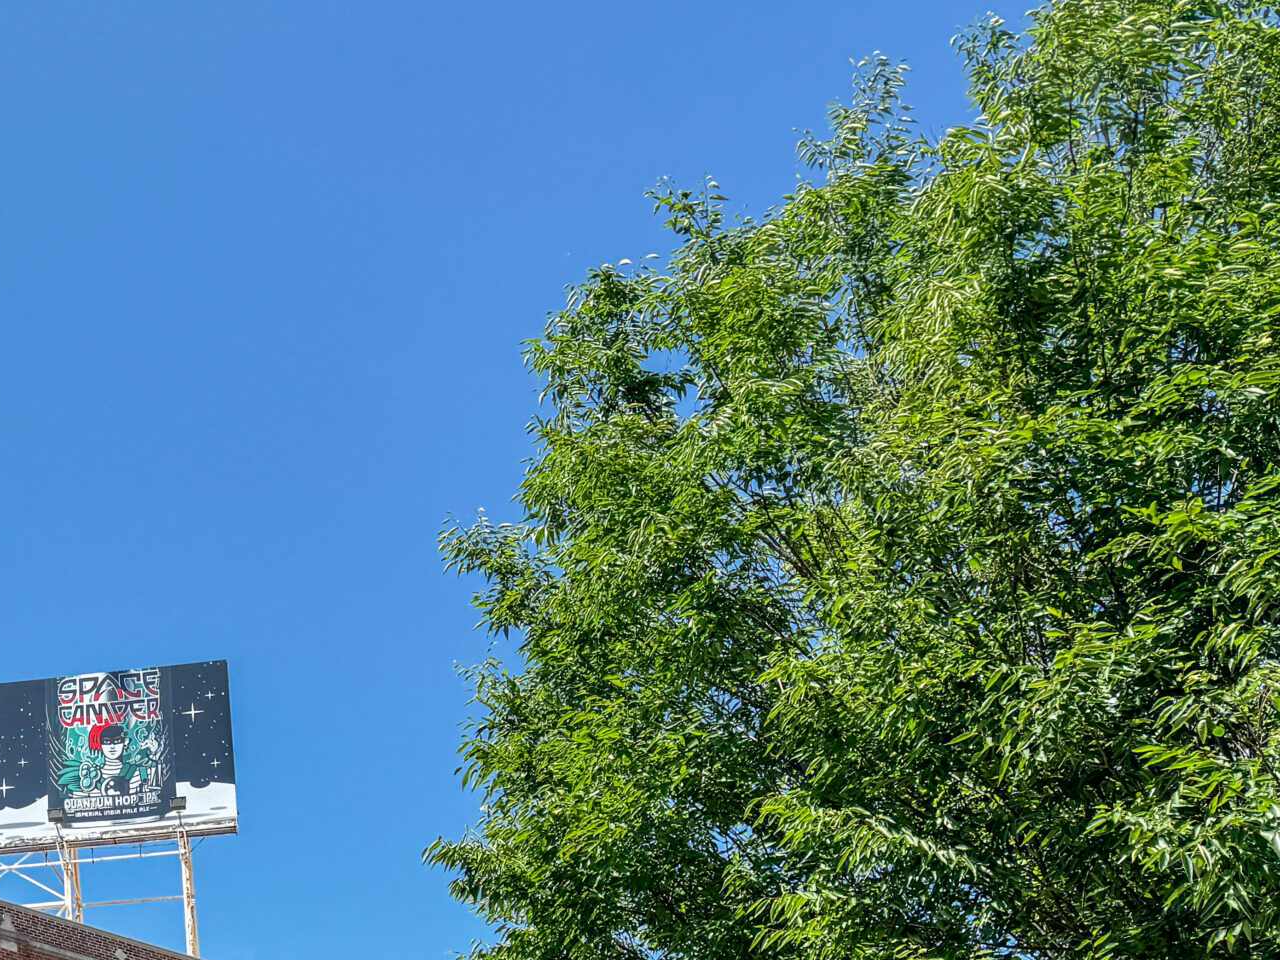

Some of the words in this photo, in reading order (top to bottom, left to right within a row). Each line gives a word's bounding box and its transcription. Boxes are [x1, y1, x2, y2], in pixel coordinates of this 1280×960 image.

[57, 672, 160, 705] SPACE
[57, 698, 160, 728] CAMPER
[64, 797, 113, 812] QUANTUM
[114, 795, 138, 807] HOP
[140, 791, 160, 804] IPA
[75, 810, 103, 818] IMPERIAL
[122, 807, 138, 815] PALE
